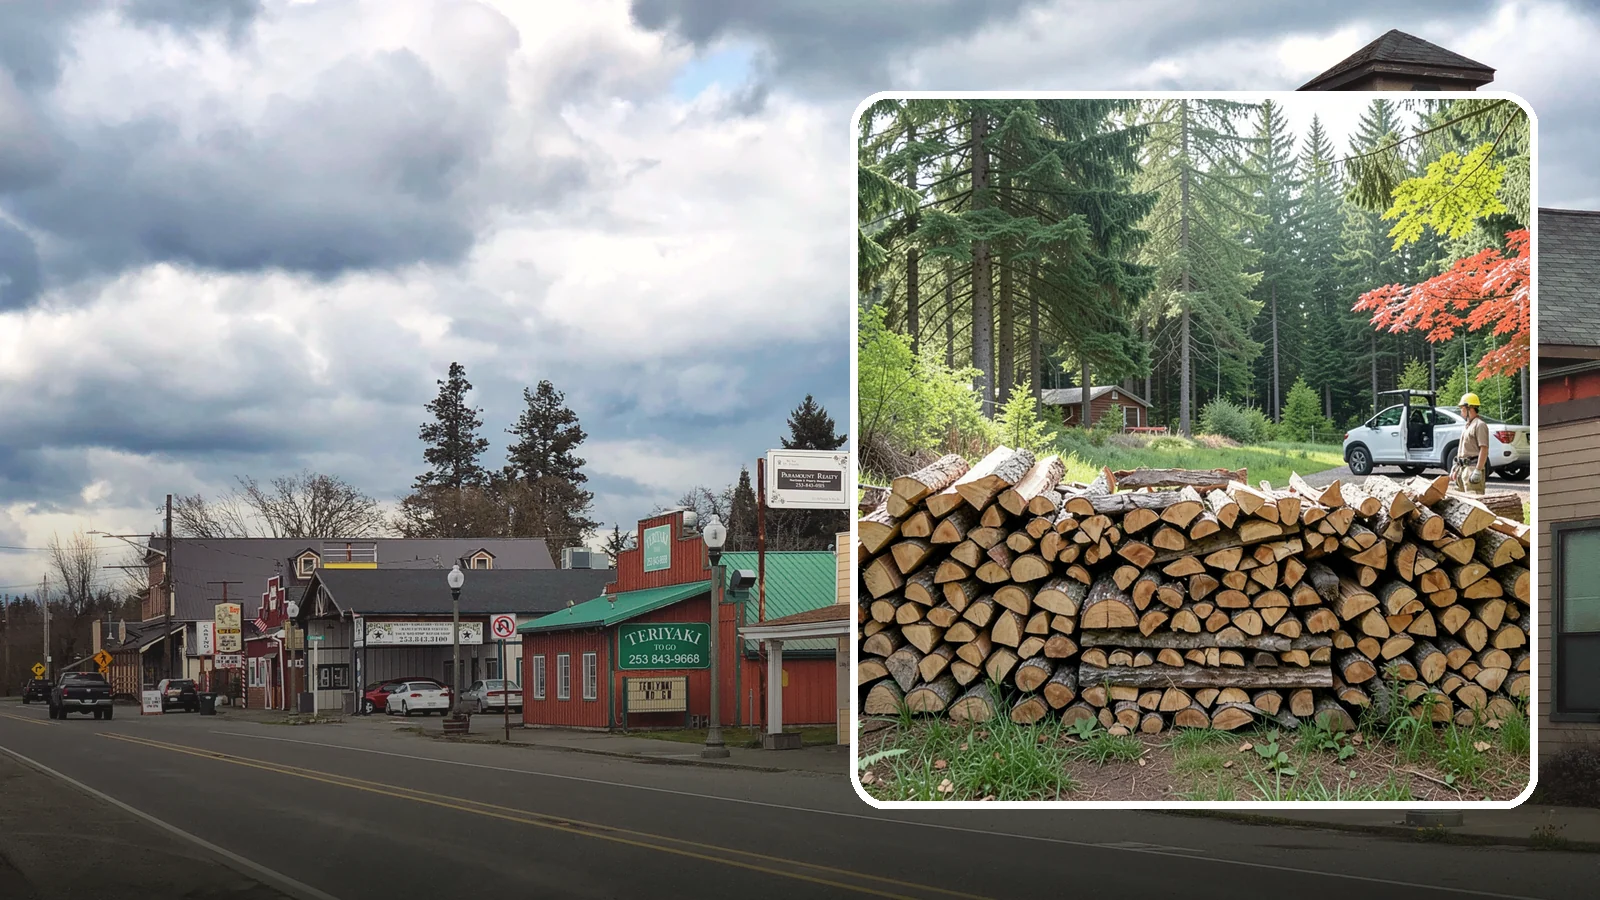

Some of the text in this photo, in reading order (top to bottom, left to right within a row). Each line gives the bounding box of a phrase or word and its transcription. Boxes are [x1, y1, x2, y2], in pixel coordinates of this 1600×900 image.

[624, 627, 702, 646] TERIYAKI
[628, 653, 700, 665] 253 843-9668
